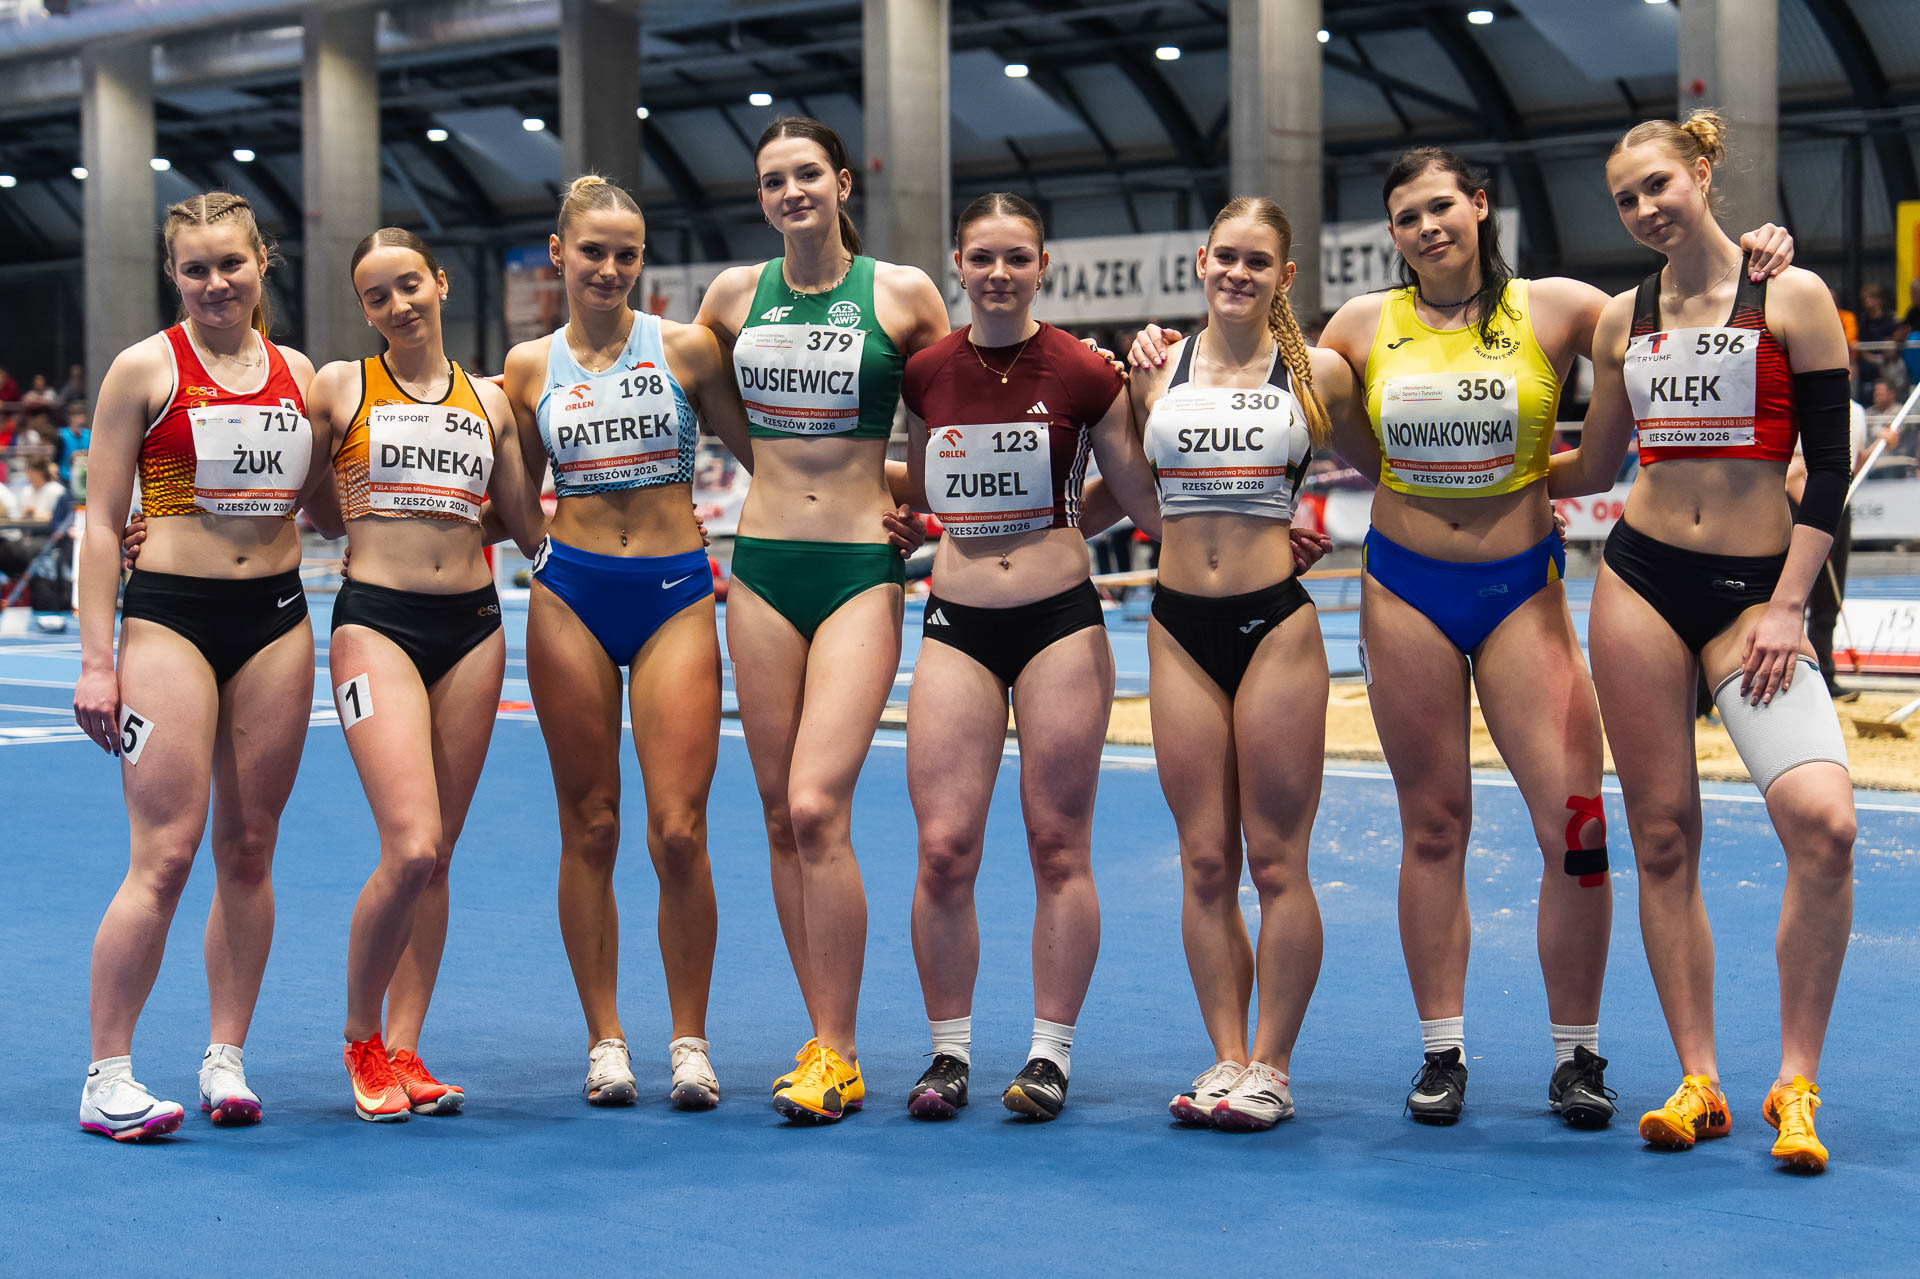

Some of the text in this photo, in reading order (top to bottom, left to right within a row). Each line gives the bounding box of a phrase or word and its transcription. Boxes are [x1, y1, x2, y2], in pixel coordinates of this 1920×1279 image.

[1042, 258, 1142, 302] WIĄZEK
[1324, 246, 1394, 283] LETY
[761, 305, 794, 322] 4F
[835, 305, 854, 313] AZS
[833, 316, 856, 325] AWF
[807, 331, 853, 353] 379
[1473, 341, 1520, 360] SKIERNIEWICE
[1695, 333, 1745, 356] 596
[1637, 354, 1672, 363] TRYUMF
[619, 374, 664, 399] 198
[741, 366, 854, 395] DUSIEWICZ
[1457, 378, 1506, 402] 350
[1650, 375, 1721, 407] KLĘK
[565, 400, 595, 412] ORLEN
[1231, 393, 1280, 410] 330
[398, 415, 430, 423] SPORT
[775, 408, 809, 416] Mistrzostwa
[259, 411, 299, 432] 717
[445, 412, 484, 440] 544
[557, 412, 673, 449] PATEREK
[762, 415, 836, 431] RZESZÓW 2026
[991, 430, 1039, 454] 123
[1178, 427, 1264, 453] SZULC
[1387, 419, 1513, 448] NOWAKOWSKA
[1699, 431, 1730, 442] 2026
[232, 443, 284, 475] ŻUK
[381, 444, 483, 481] DENEKA
[596, 458, 633, 468] Mistrzostwa
[938, 450, 966, 459] ORLEN
[583, 464, 658, 482] RZESZÓW 2026
[1468, 462, 1487, 470] Polski
[945, 472, 1028, 499] ZUBEL
[1182, 480, 1264, 491] RZESZÓW 2026
[1412, 473, 1495, 485] RZESZÓW 2026
[217, 500, 291, 512] RZESZÓW 202
[393, 496, 469, 513] RZESZÓW 2026
[1003, 511, 1023, 519] Polski
[949, 522, 1031, 536] RZESZÓW 2026
[345, 681, 362, 719] 1
[121, 713, 144, 754] 5
